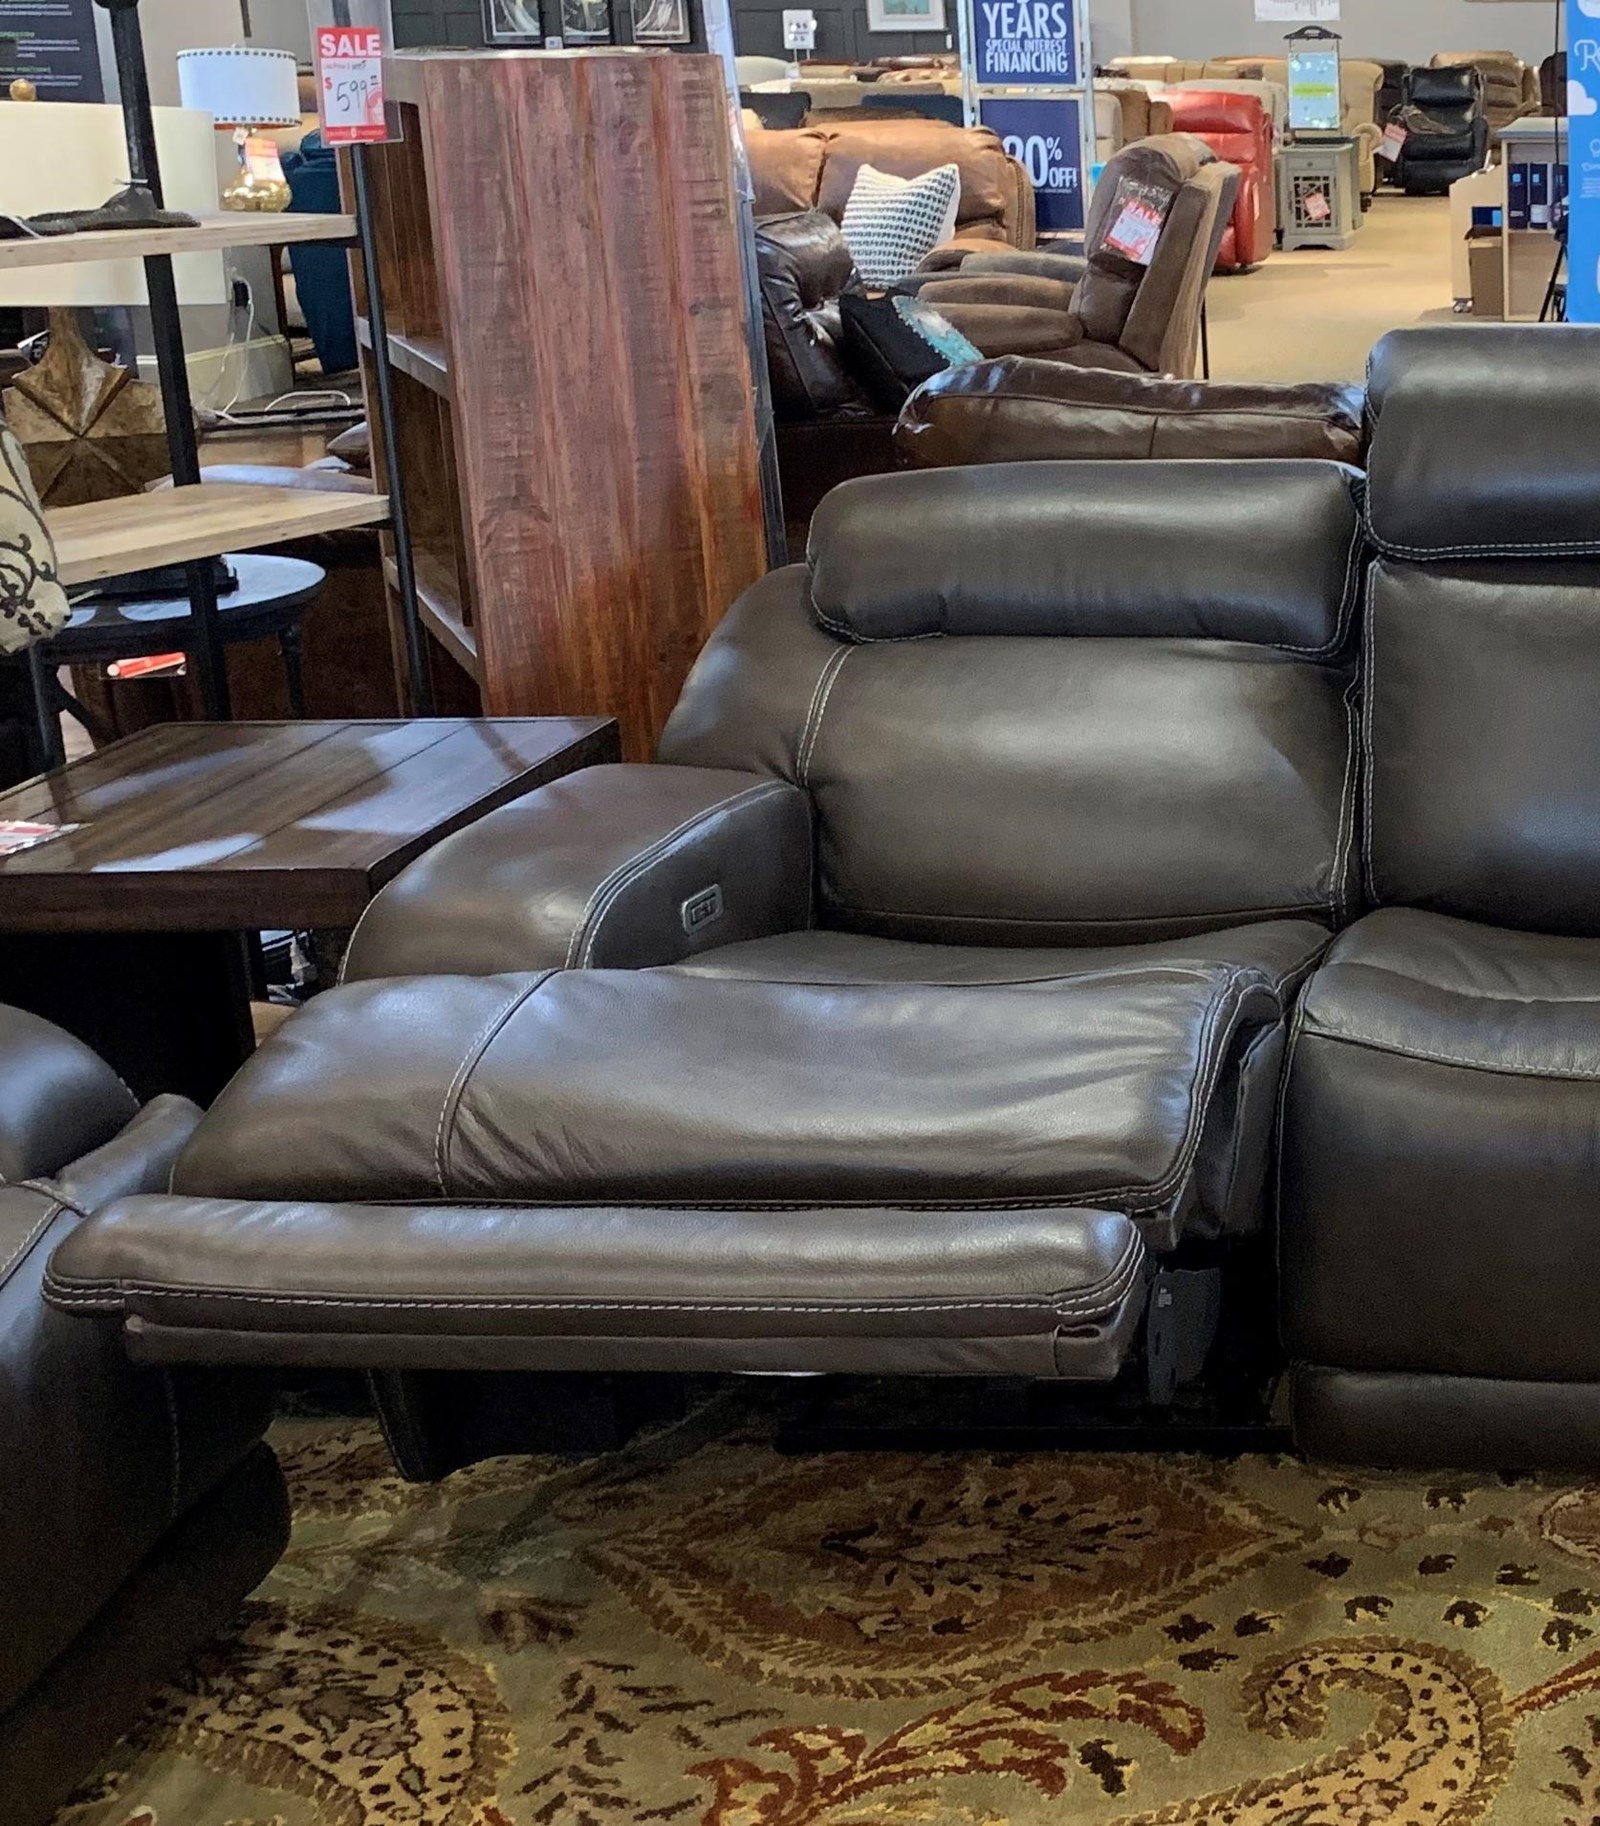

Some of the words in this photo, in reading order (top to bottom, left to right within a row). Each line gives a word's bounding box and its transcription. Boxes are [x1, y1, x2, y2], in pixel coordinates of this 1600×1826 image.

[982, 2, 1067, 39] YEARS
[320, 33, 381, 57] SALE
[986, 39, 1021, 54] SPECIAL
[1024, 39, 1067, 53] INTEREST
[986, 51, 1069, 73] FINANCING
[1049, 167, 1078, 188] OFF!
